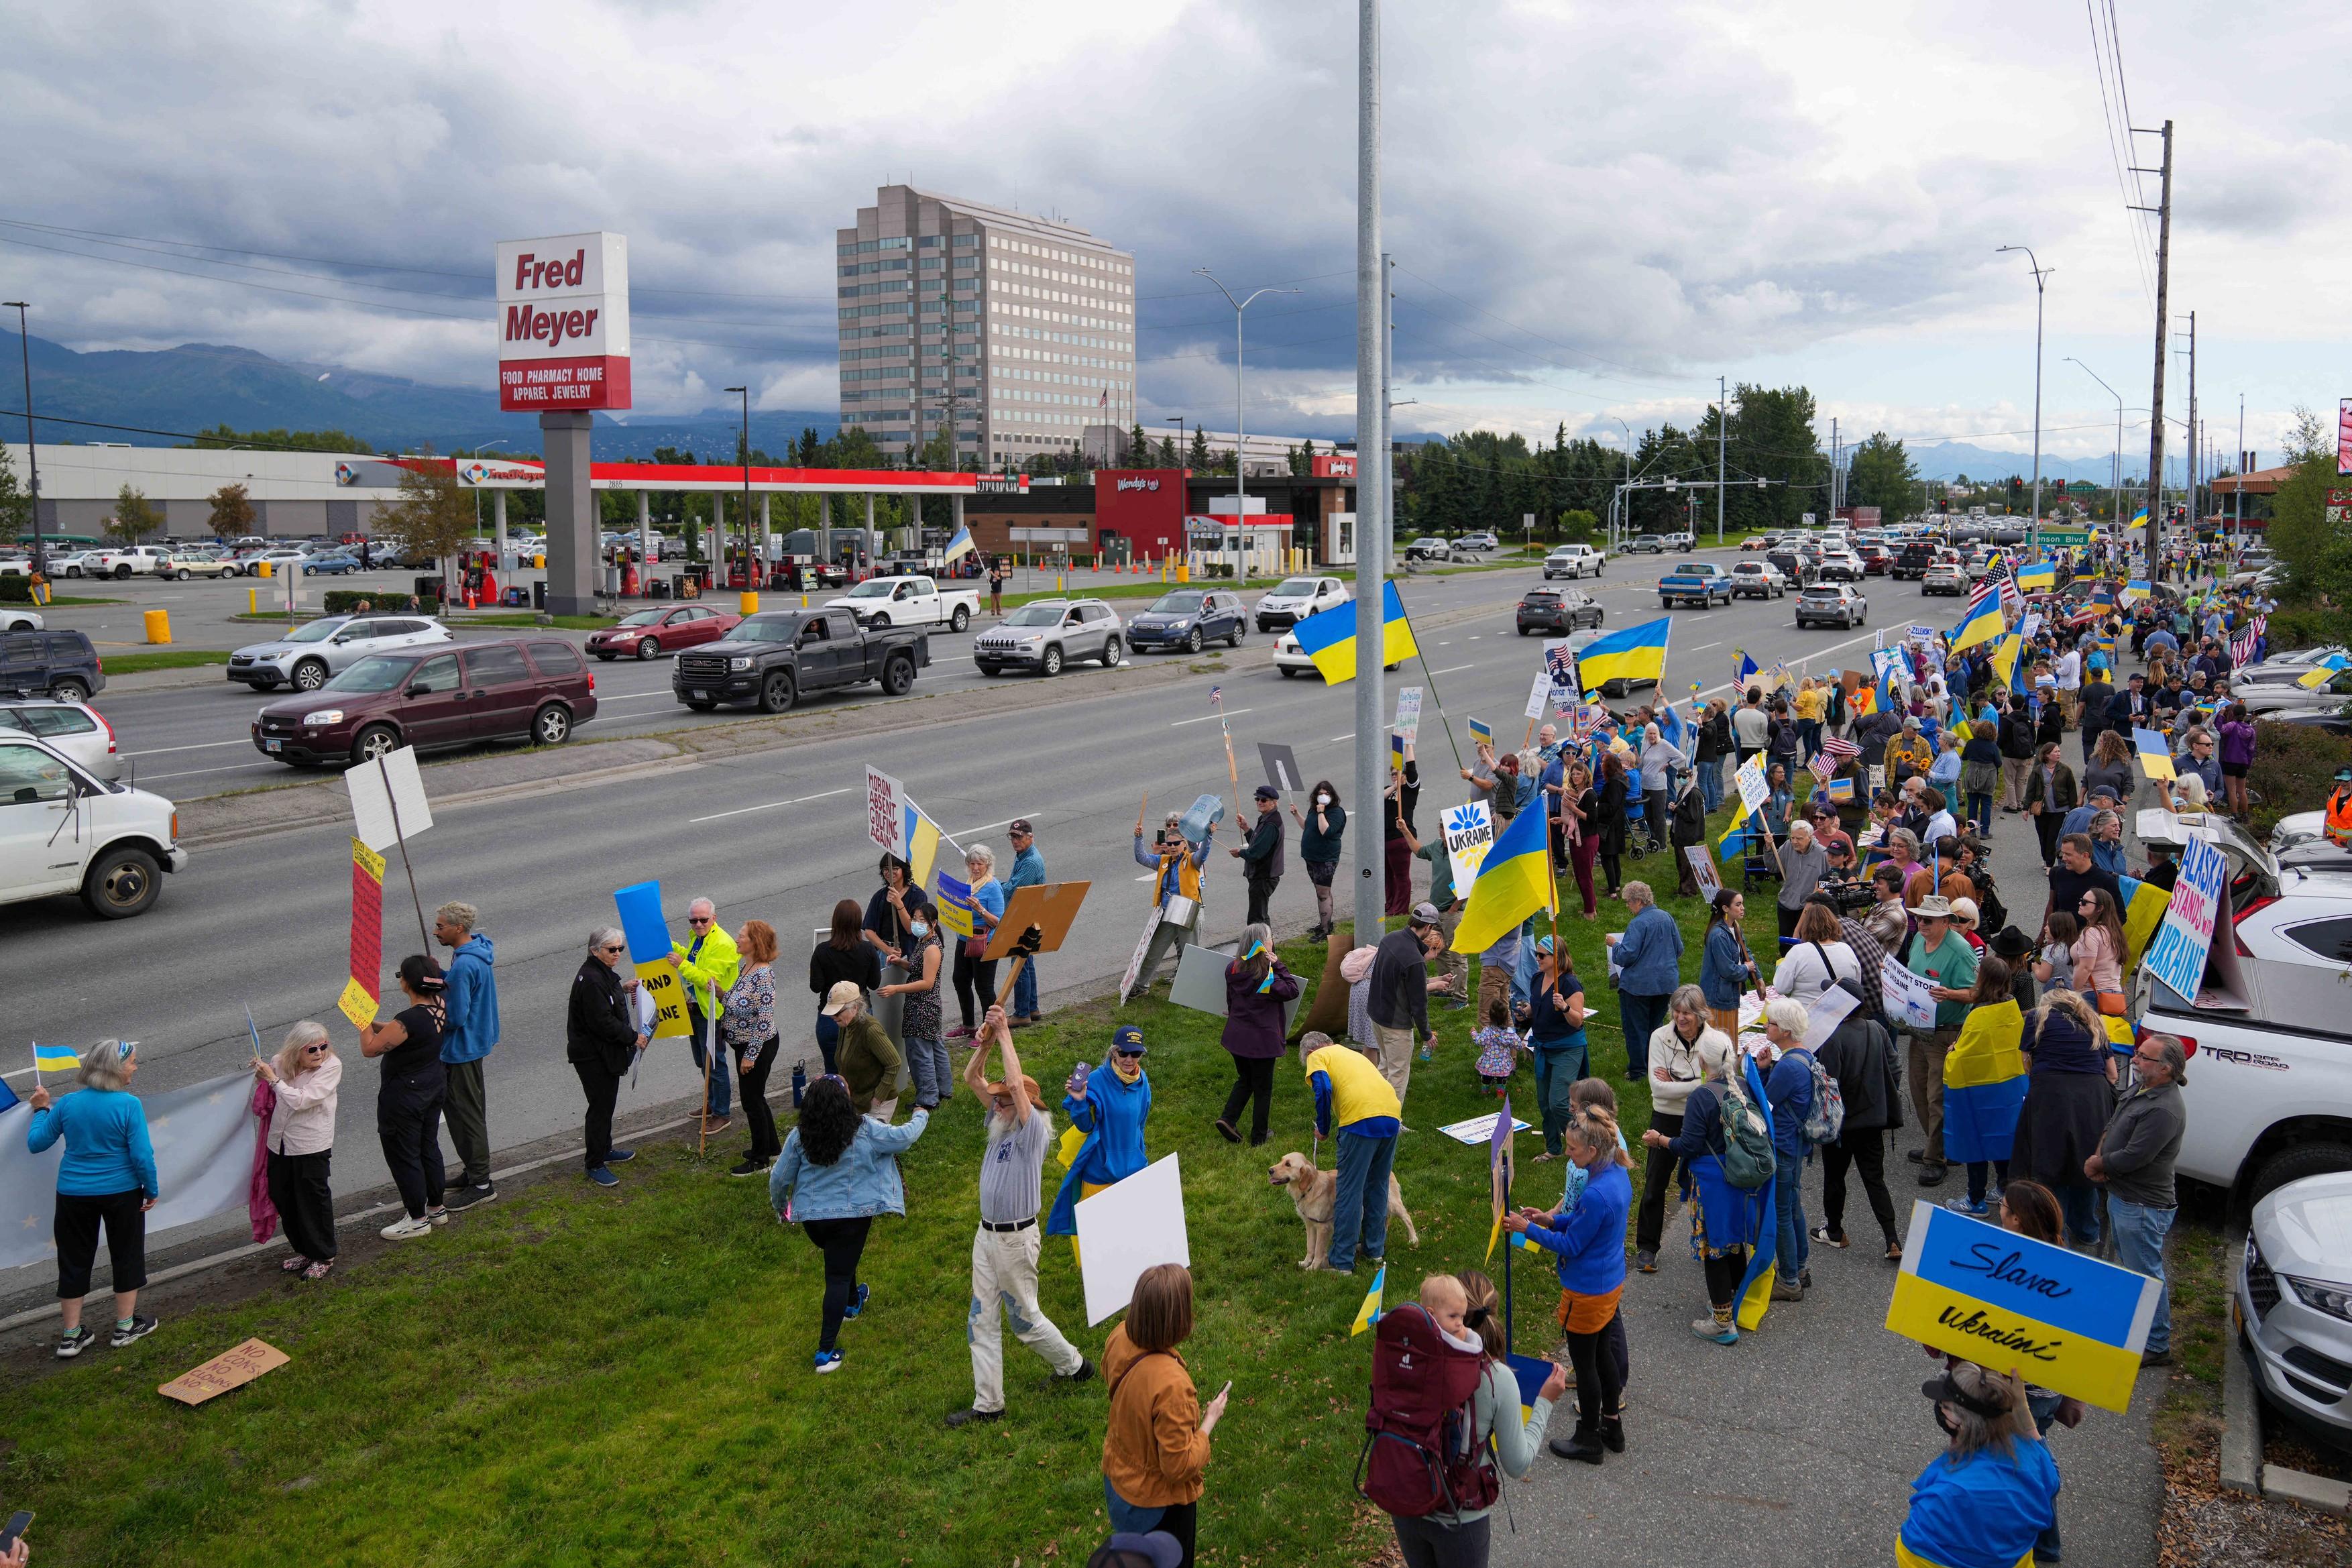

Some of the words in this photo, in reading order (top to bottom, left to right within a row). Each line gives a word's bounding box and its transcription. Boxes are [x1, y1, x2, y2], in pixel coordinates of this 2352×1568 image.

[516, 249, 584, 290] Fred
[506, 305, 598, 347] Meyer
[503, 372, 523, 385] FOOD
[527, 369, 572, 383] PHARMACY
[577, 368, 603, 380] HOME
[513, 386, 548, 400] APPAREL
[553, 385, 591, 399] JEWELRY
[608, 480, 622, 488] 2885
[1117, 477, 1146, 492] Wendy's
[1911, 627, 1933, 636] ZELENSKY
[1549, 687, 1565, 696] Honor
[1568, 687, 1578, 697] the
[1552, 699, 1580, 708] Promises
[1740, 763, 1756, 785] JESUS
[869, 773, 891, 799] MORON
[869, 791, 896, 821] ABSENT
[870, 807, 898, 840] GOLFING
[1449, 826, 1491, 852] UKRAINE
[942, 887, 950, 897] Peace
[2170, 879, 2205, 931] STANDS
[2202, 915, 2213, 940] WITH
[946, 912, 954, 921] Come
[955, 917, 967, 928] Home
[2147, 921, 2205, 1000] UKRAINE
[1885, 957, 1897, 970] PUTIN
[1897, 966, 1913, 983] WON'T
[1883, 968, 1889, 976] AT
[1890, 972, 1909, 992] UKRAINE
[2200, 1046, 2252, 1064] TRD
[2253, 1054, 2280, 1062] OFF
[2253, 1060, 2290, 1069] ROAD
[1448, 1123, 1472, 1131] CHANGE
[1473, 1116, 1499, 1125] HAPPENS
[1949, 1243, 2071, 1298] Slava
[239, 1345, 266, 1358] NO
[207, 1362, 231, 1374] NO
[178, 1378, 201, 1388] NO
[190, 1369, 233, 1388] CLOWNS
